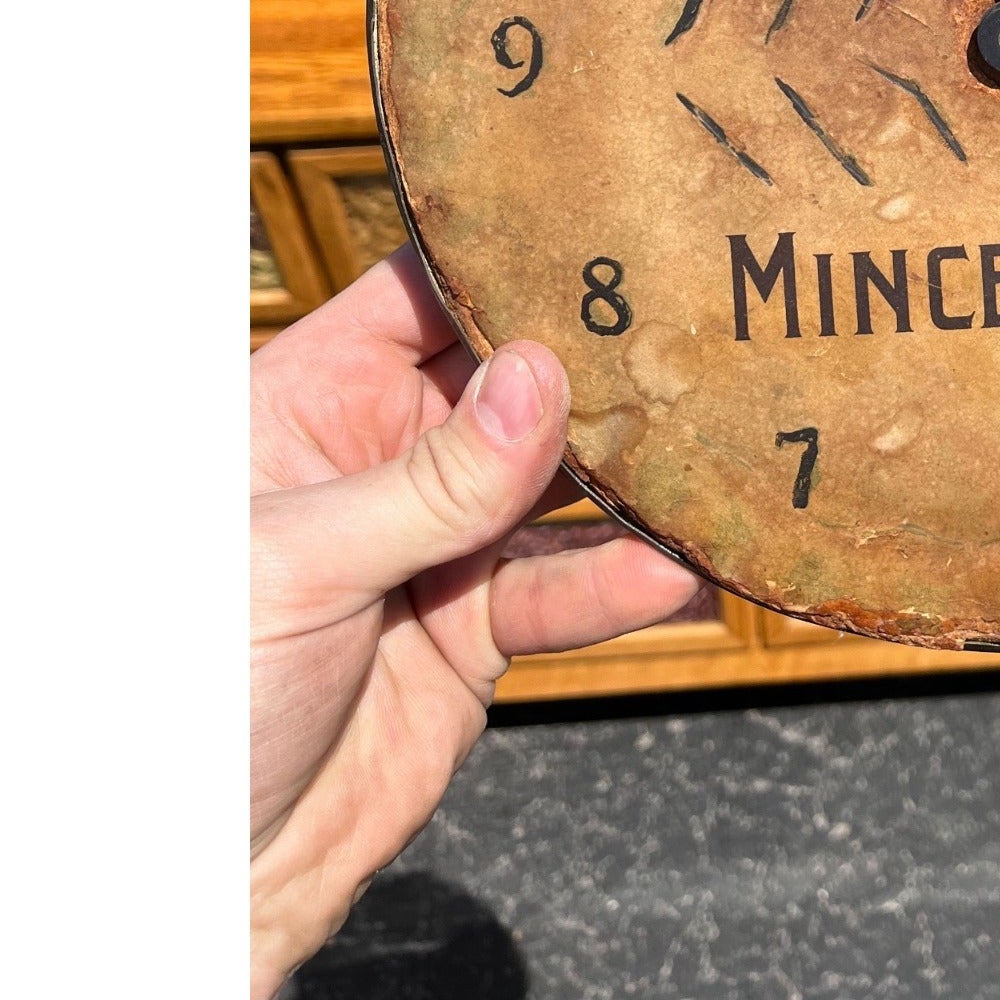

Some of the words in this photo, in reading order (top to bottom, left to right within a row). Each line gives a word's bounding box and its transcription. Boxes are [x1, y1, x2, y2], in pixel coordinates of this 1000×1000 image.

[489, 14, 545, 99] 9
[579, 255, 634, 338] 8
[773, 426, 820, 511] 7
